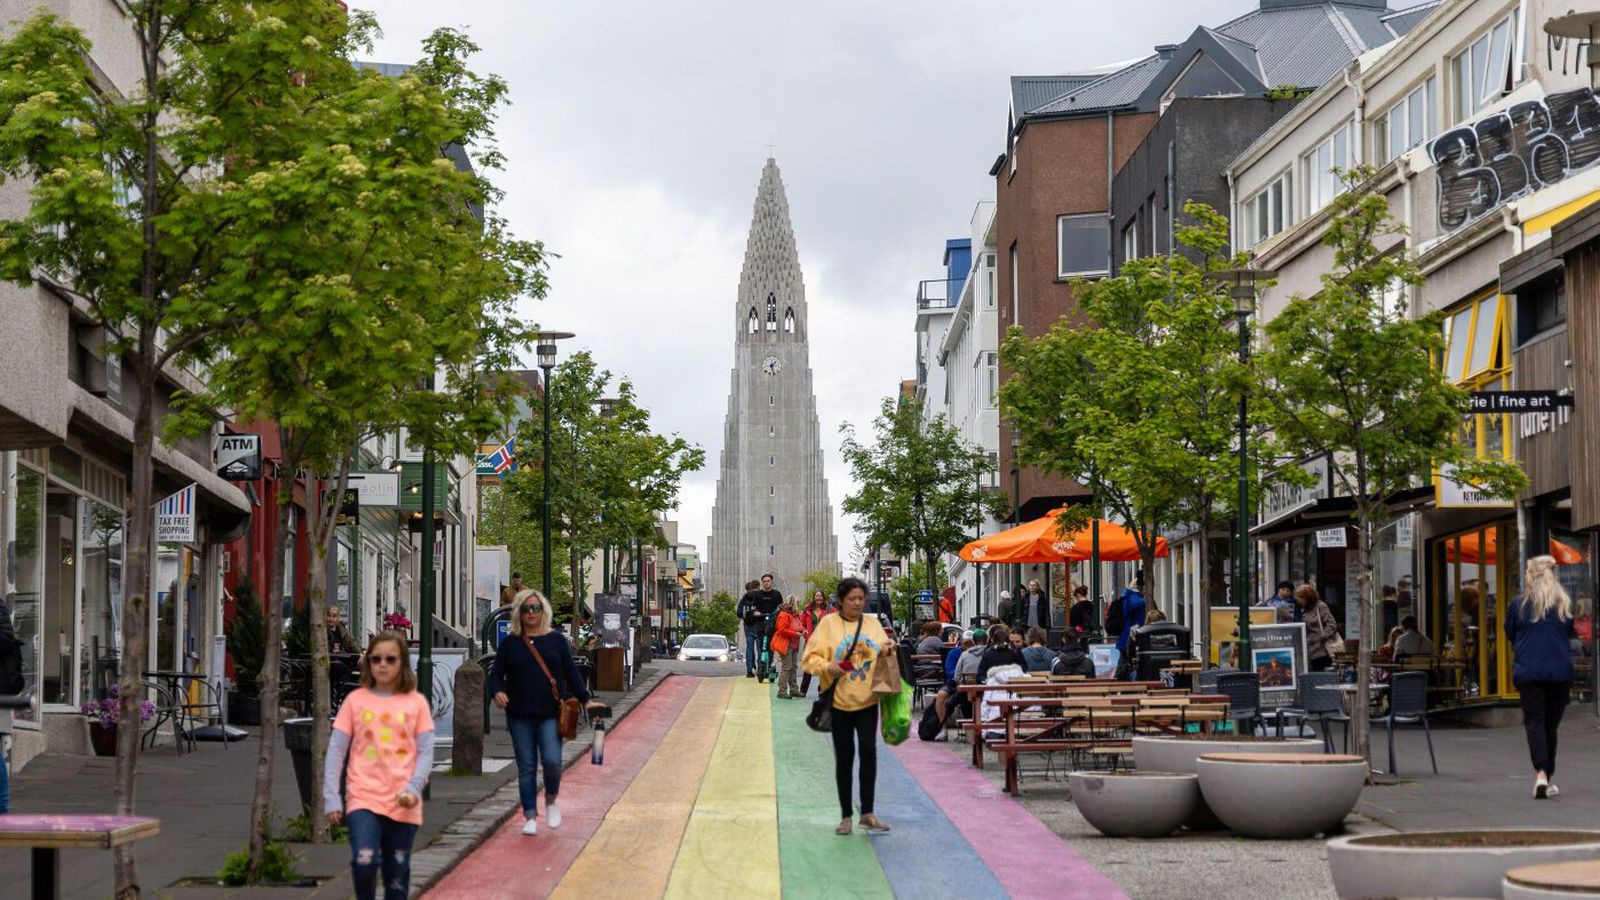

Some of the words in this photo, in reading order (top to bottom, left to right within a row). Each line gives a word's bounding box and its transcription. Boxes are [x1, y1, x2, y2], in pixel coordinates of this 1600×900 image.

[1499, 395, 1526, 407] fine
[1530, 395, 1550, 407] art
[222, 438, 253, 450] ATM
[160, 517, 171, 525] TAX
[174, 517, 190, 525] FREE
[159, 526, 190, 535] SHOPPING
